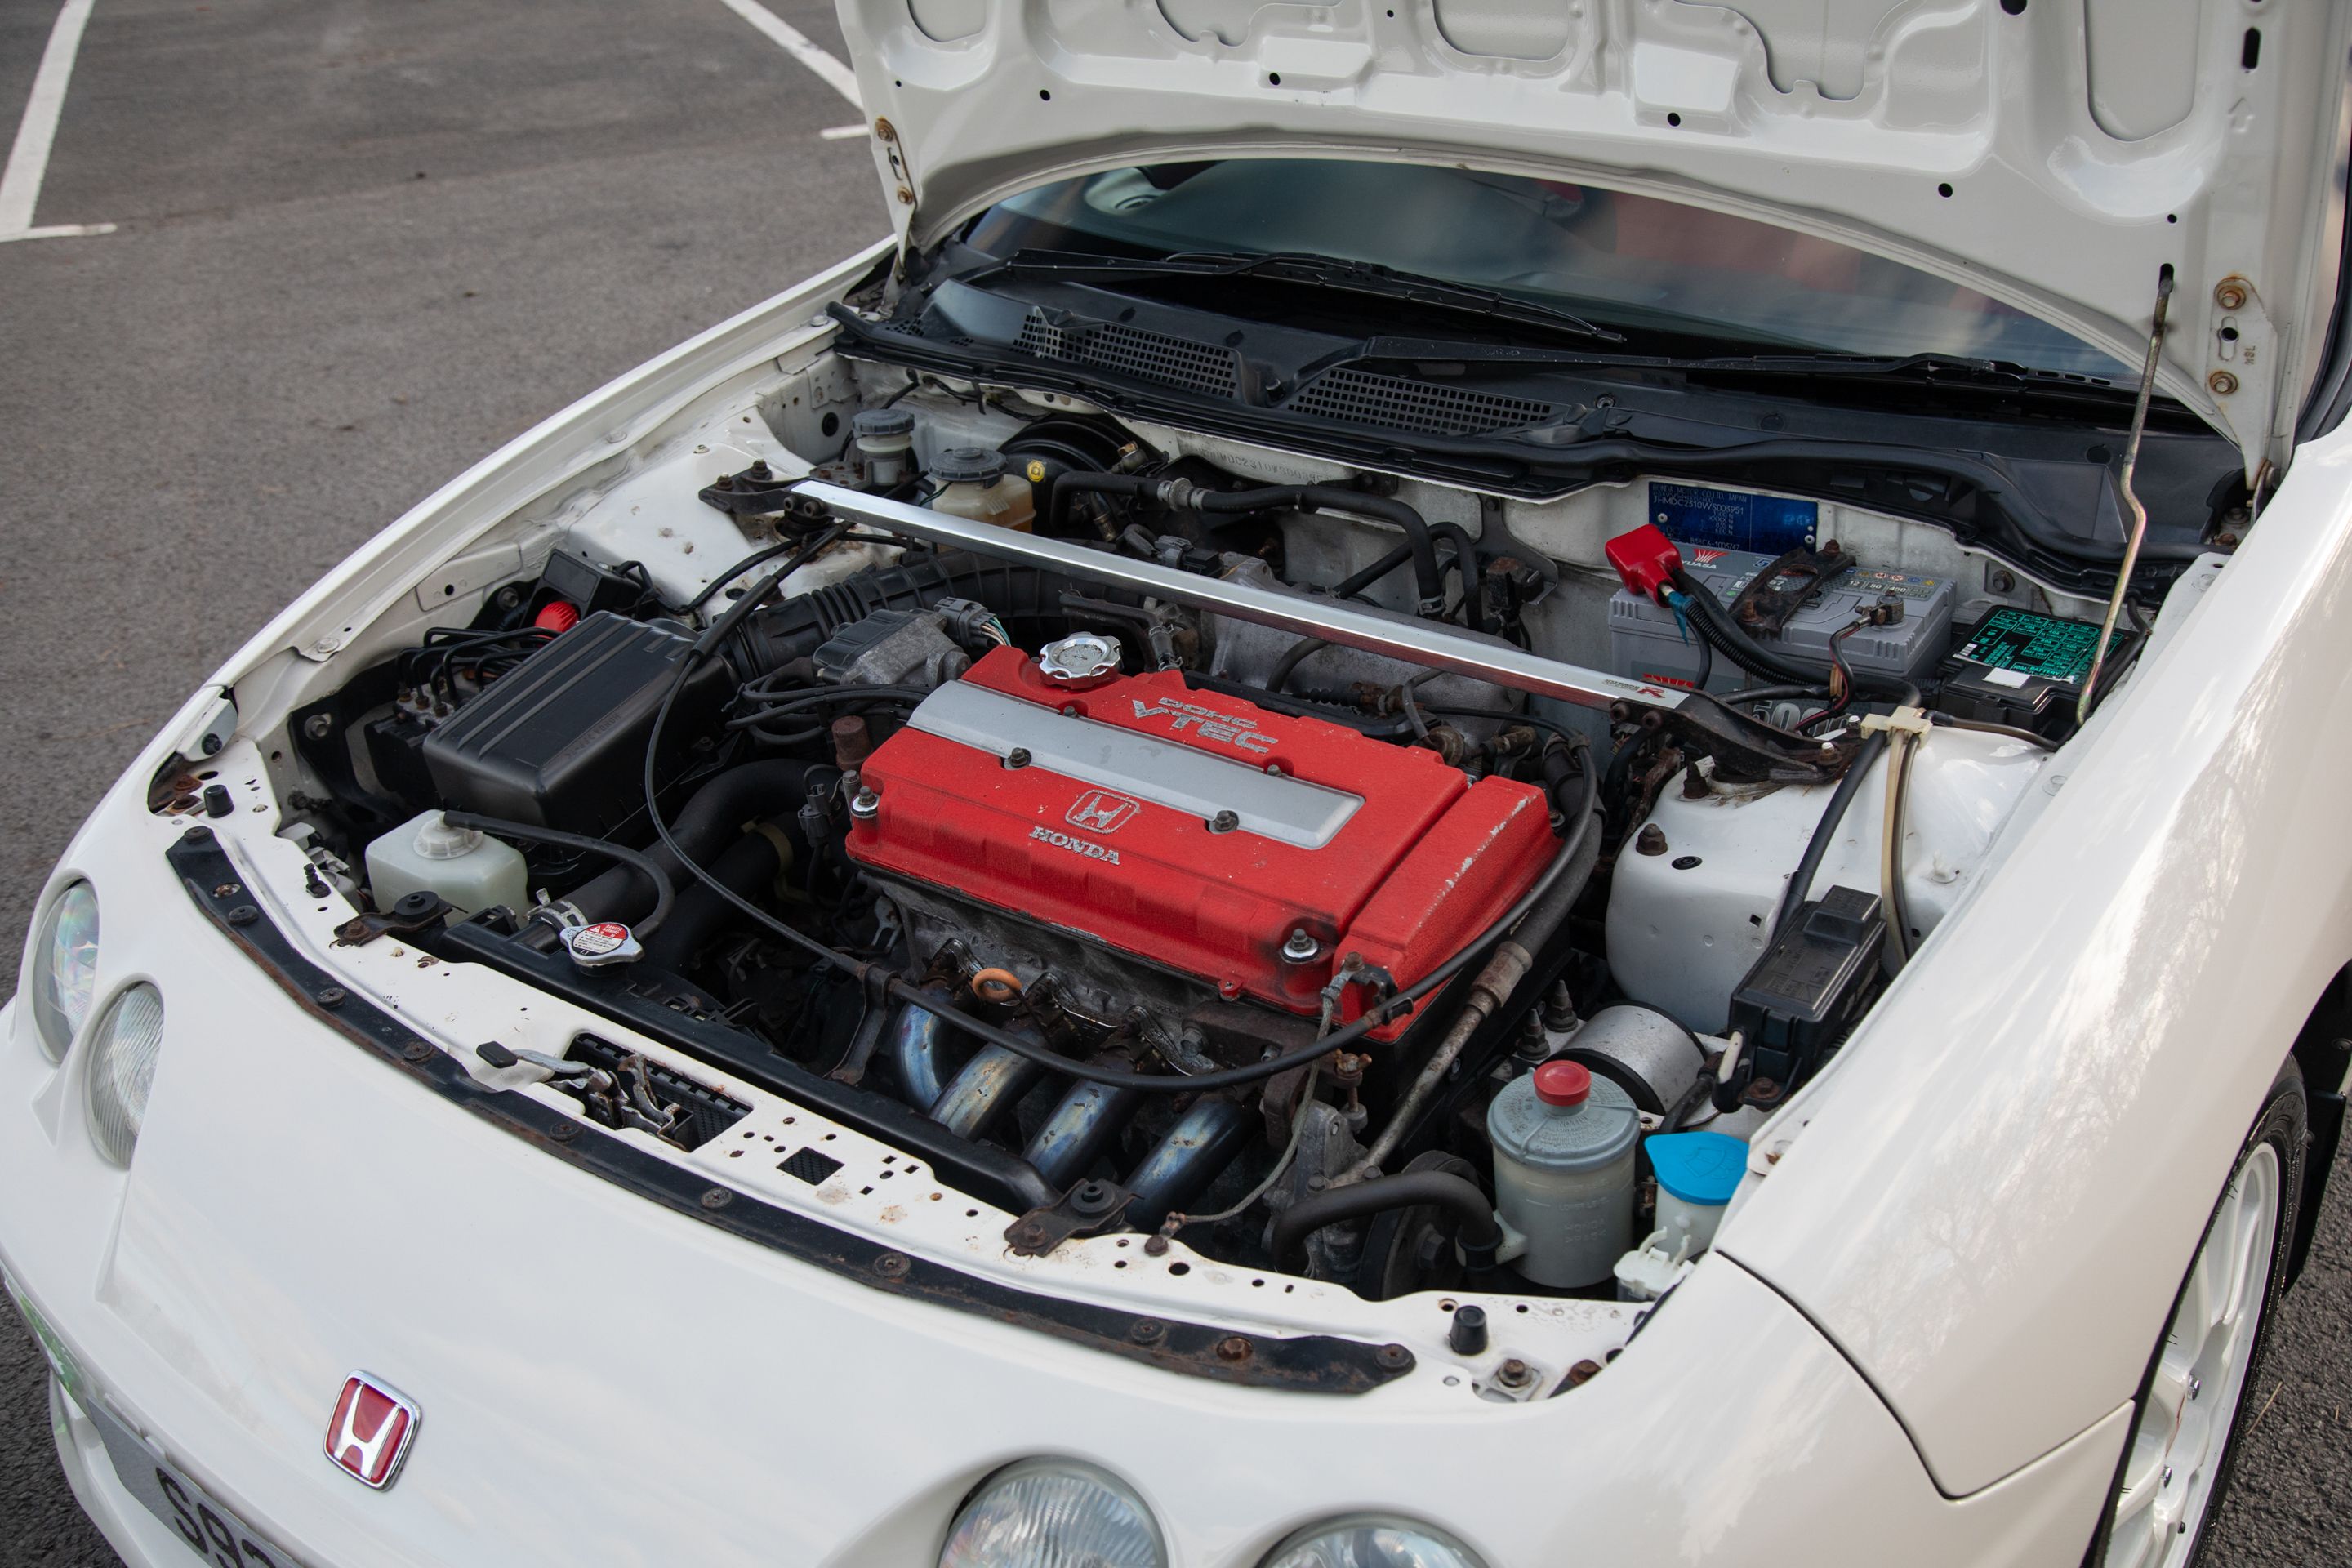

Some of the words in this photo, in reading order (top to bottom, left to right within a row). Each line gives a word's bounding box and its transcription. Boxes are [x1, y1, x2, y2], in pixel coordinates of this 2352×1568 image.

[1682, 559, 1717, 570] YUASA
[1132, 699, 1279, 754] VTEC
[1158, 697, 1258, 728] DOHC
[1029, 826, 1120, 866] HONDA
